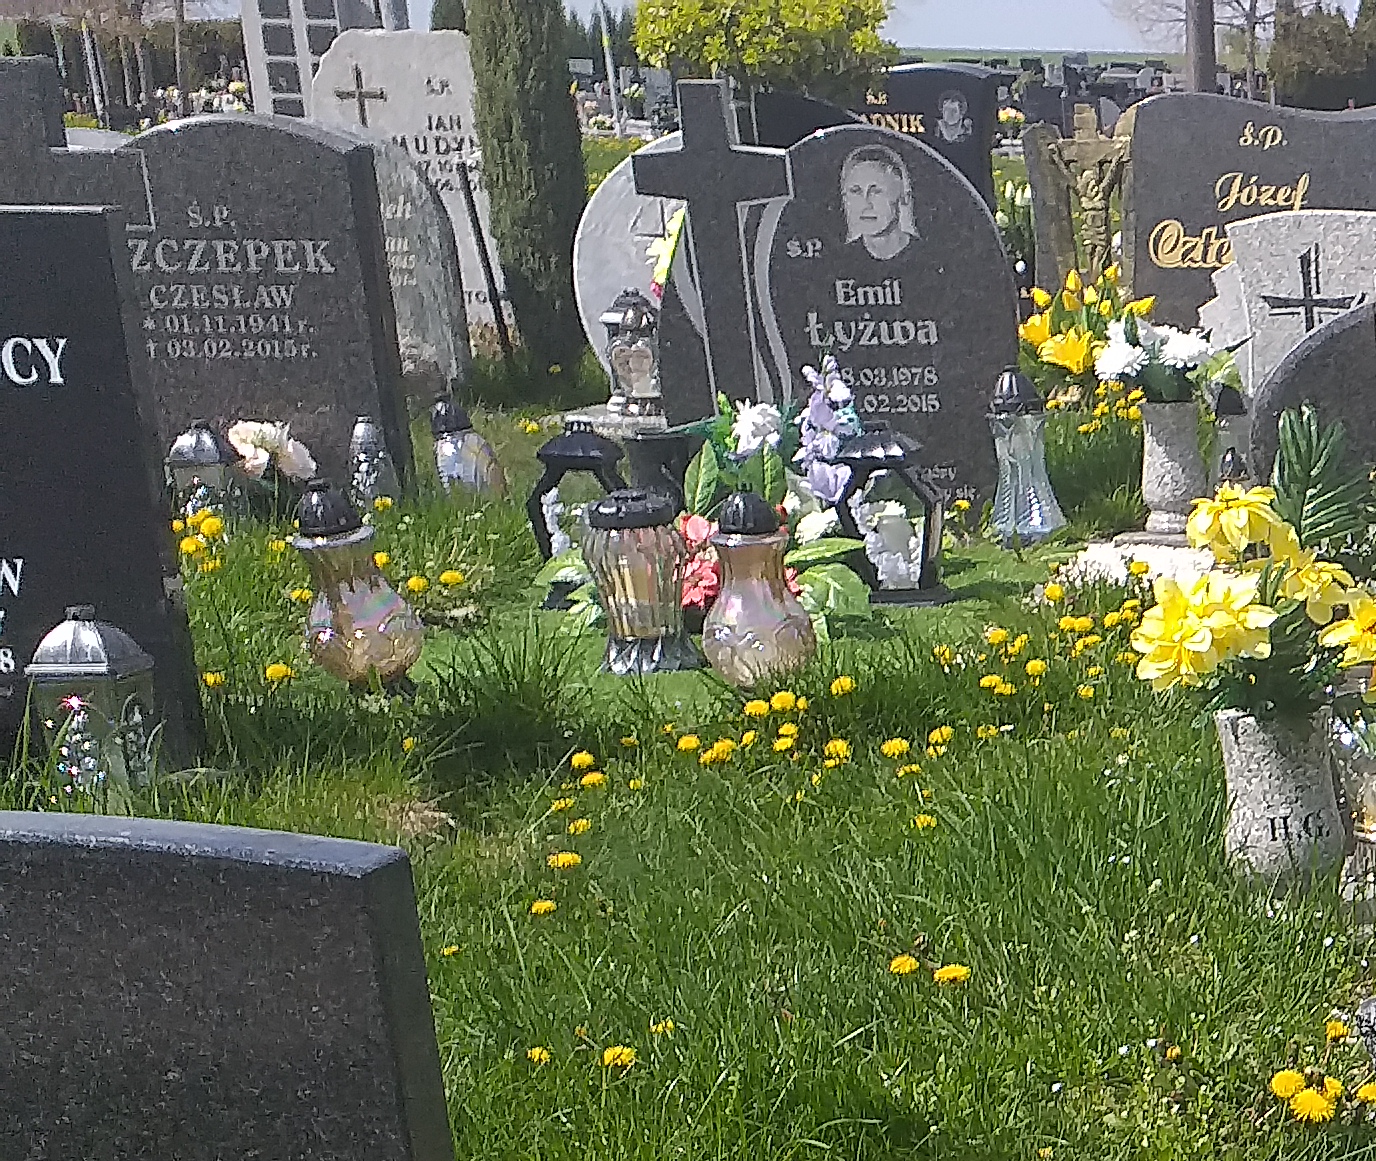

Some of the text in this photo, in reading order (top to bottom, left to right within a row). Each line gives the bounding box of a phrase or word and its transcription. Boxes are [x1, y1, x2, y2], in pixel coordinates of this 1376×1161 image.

[862, 112, 925, 133] DNIK
[1215, 171, 1311, 212] Józef
[834, 278, 903, 306] Emil
[838, 366, 940, 387] 8.03.1978
